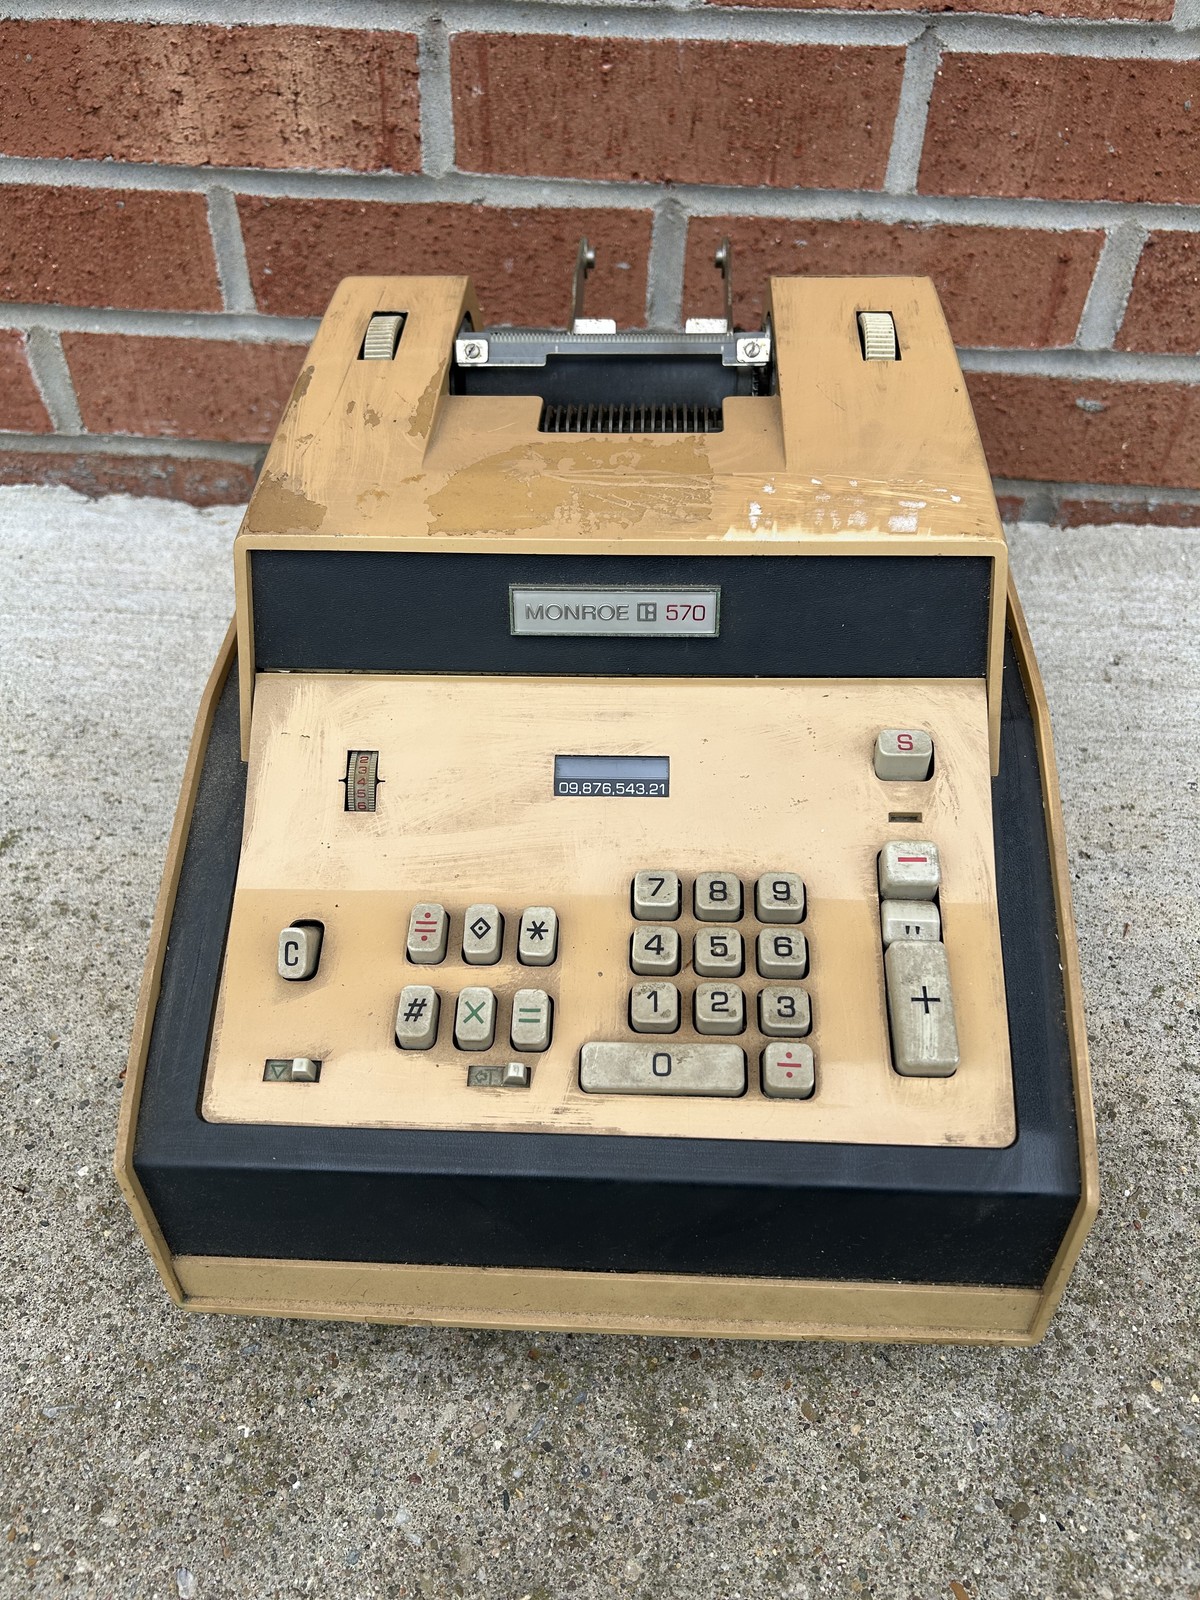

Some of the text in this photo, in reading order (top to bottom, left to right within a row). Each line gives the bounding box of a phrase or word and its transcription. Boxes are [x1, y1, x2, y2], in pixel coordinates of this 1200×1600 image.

[525, 603, 706, 621] MONROE 570
[897, 733, 914, 751] S
[358, 766, 368, 774] 3
[357, 777, 367, 787] 4
[558, 782, 666, 796] 09,876,543.21
[357, 789, 366, 798] 5
[357, 801, 367, 810] 6
[648, 878, 791, 901] 7 8 9
[284, 941, 299, 967] C
[644, 934, 793, 957] 4 5 6
[646, 990, 796, 1018] 1 2 3
